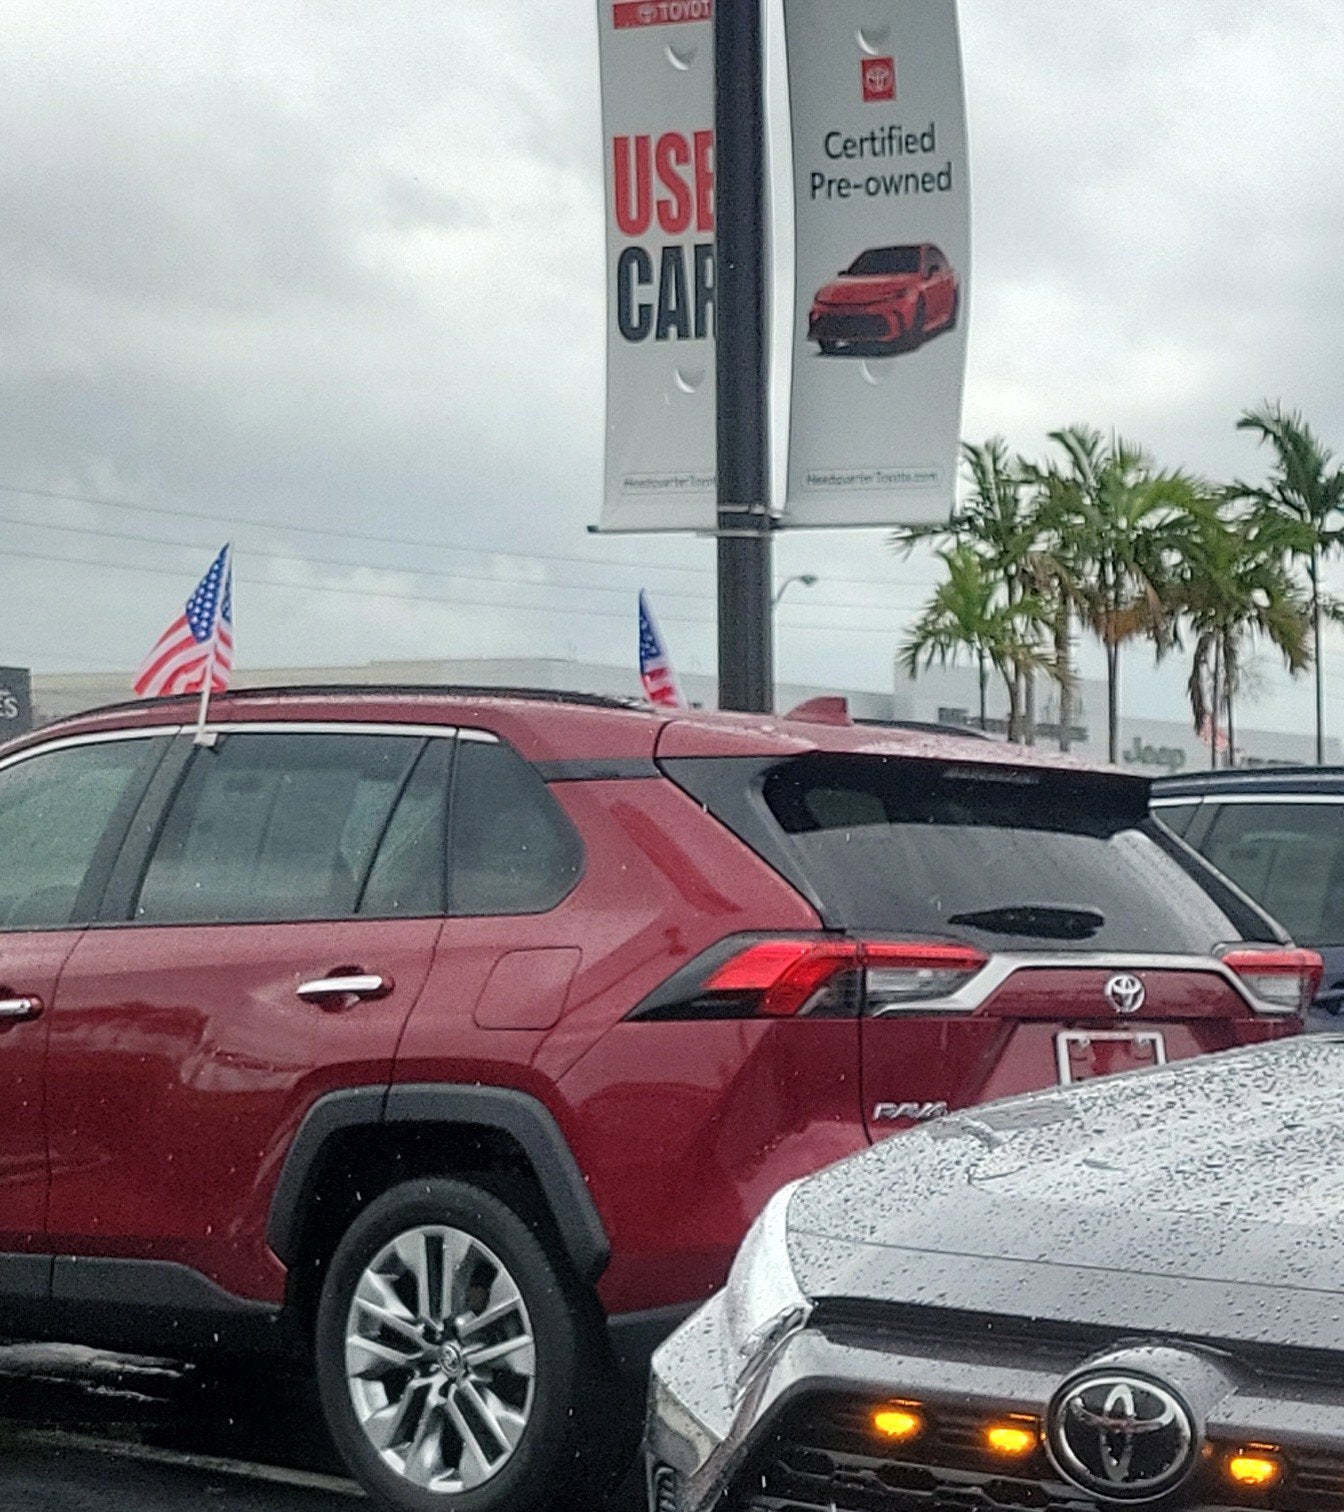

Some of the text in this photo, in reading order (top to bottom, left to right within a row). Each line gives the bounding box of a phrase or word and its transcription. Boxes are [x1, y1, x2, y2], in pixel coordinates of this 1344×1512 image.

[658, 0, 712, 20] TOYOT
[824, 121, 936, 160] Certified
[613, 130, 716, 238] USE
[810, 161, 952, 200] Pre-owned
[617, 243, 717, 344] CAR
[1122, 737, 1187, 772] Jeep
